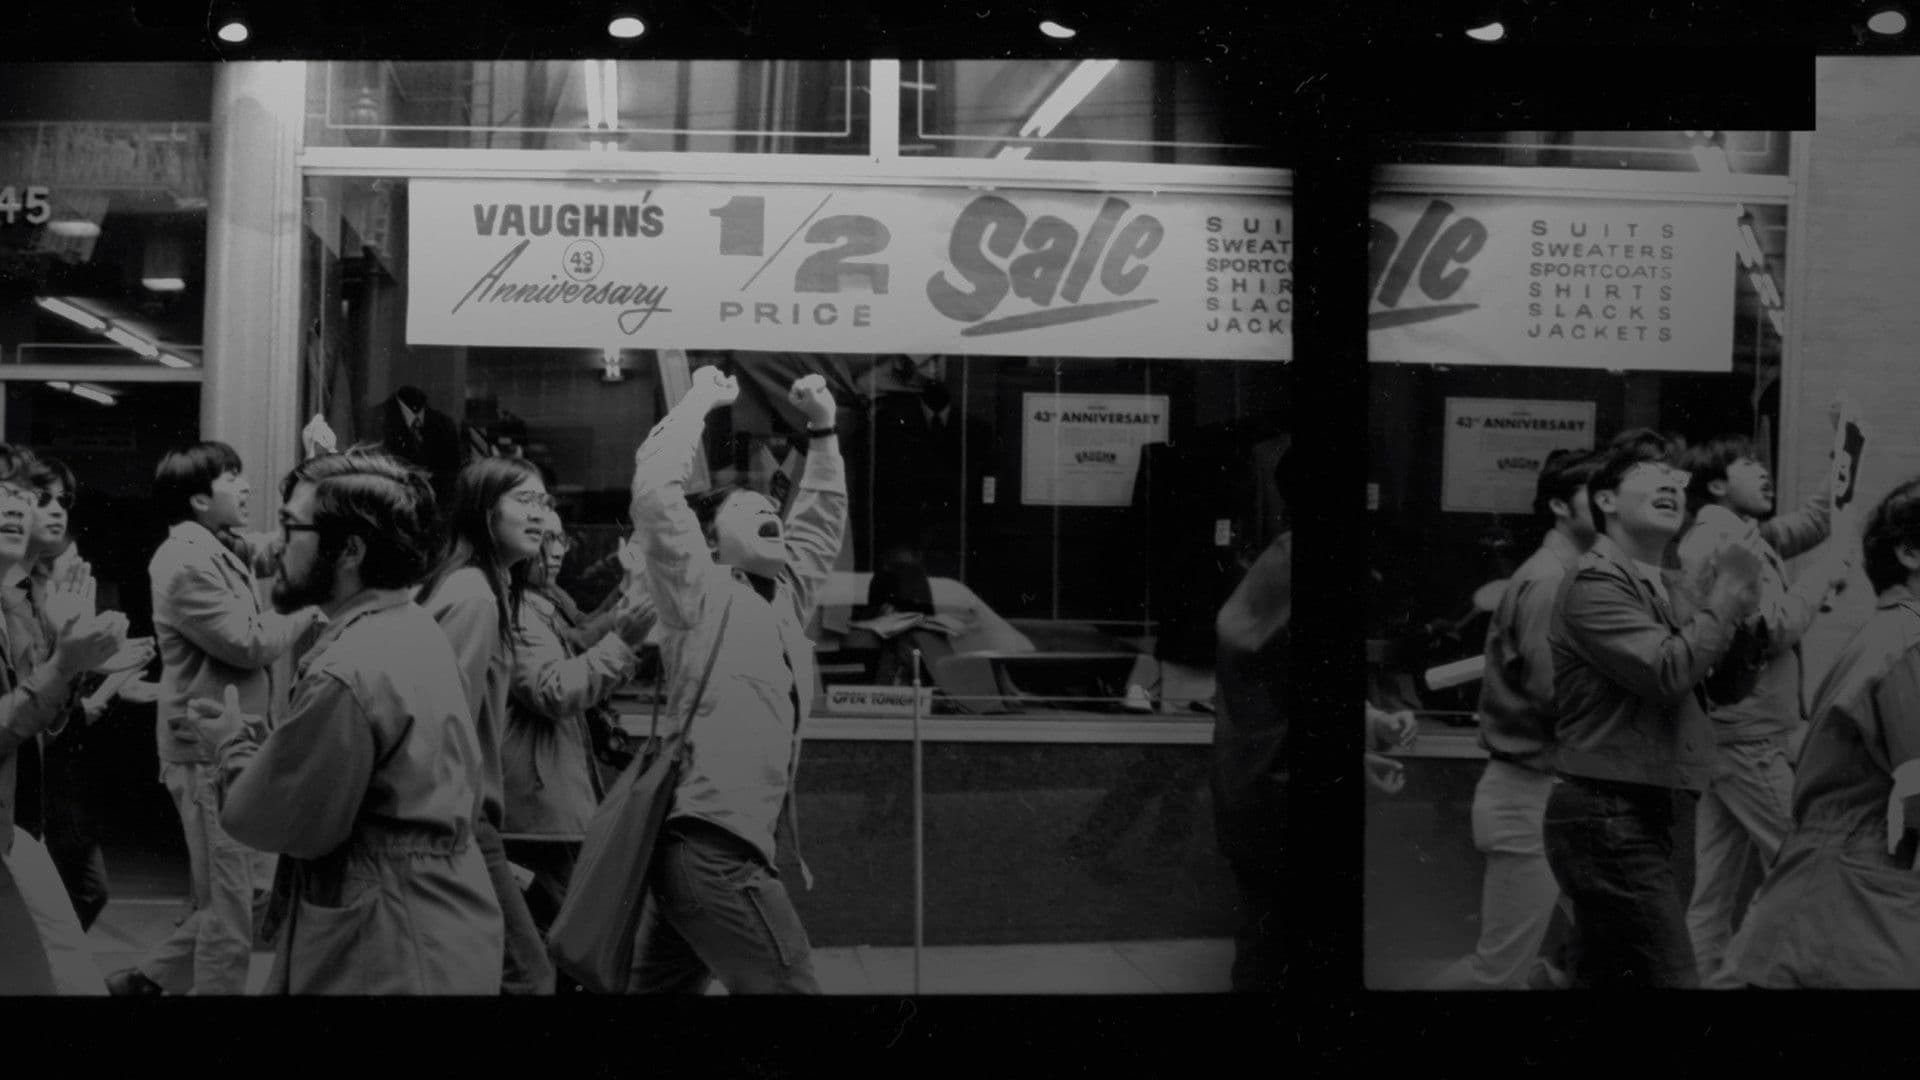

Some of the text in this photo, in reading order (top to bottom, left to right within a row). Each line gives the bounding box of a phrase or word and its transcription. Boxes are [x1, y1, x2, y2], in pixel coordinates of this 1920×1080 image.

[0, 186, 50, 224] 45
[473, 190, 665, 238] VAUGHN'S
[1530, 219, 1674, 239] SUITS
[708, 193, 891, 295] 1/2
[1530, 241, 1674, 260] SWEATERS
[570, 250, 594, 267] 43
[926, 195, 1165, 323] Sale
[1528, 262, 1673, 280] SPORTCOATS
[451, 239, 672, 335] Anniversary
[1528, 282, 1673, 301] SHIRTS
[719, 301, 872, 328] PRICE
[1527, 302, 1672, 321] SLACKS
[1526, 324, 1673, 343] JACKETS
[1060, 411, 1161, 424] ANNIVERSARY
[1484, 417, 1585, 430] ANNIVERSARY
